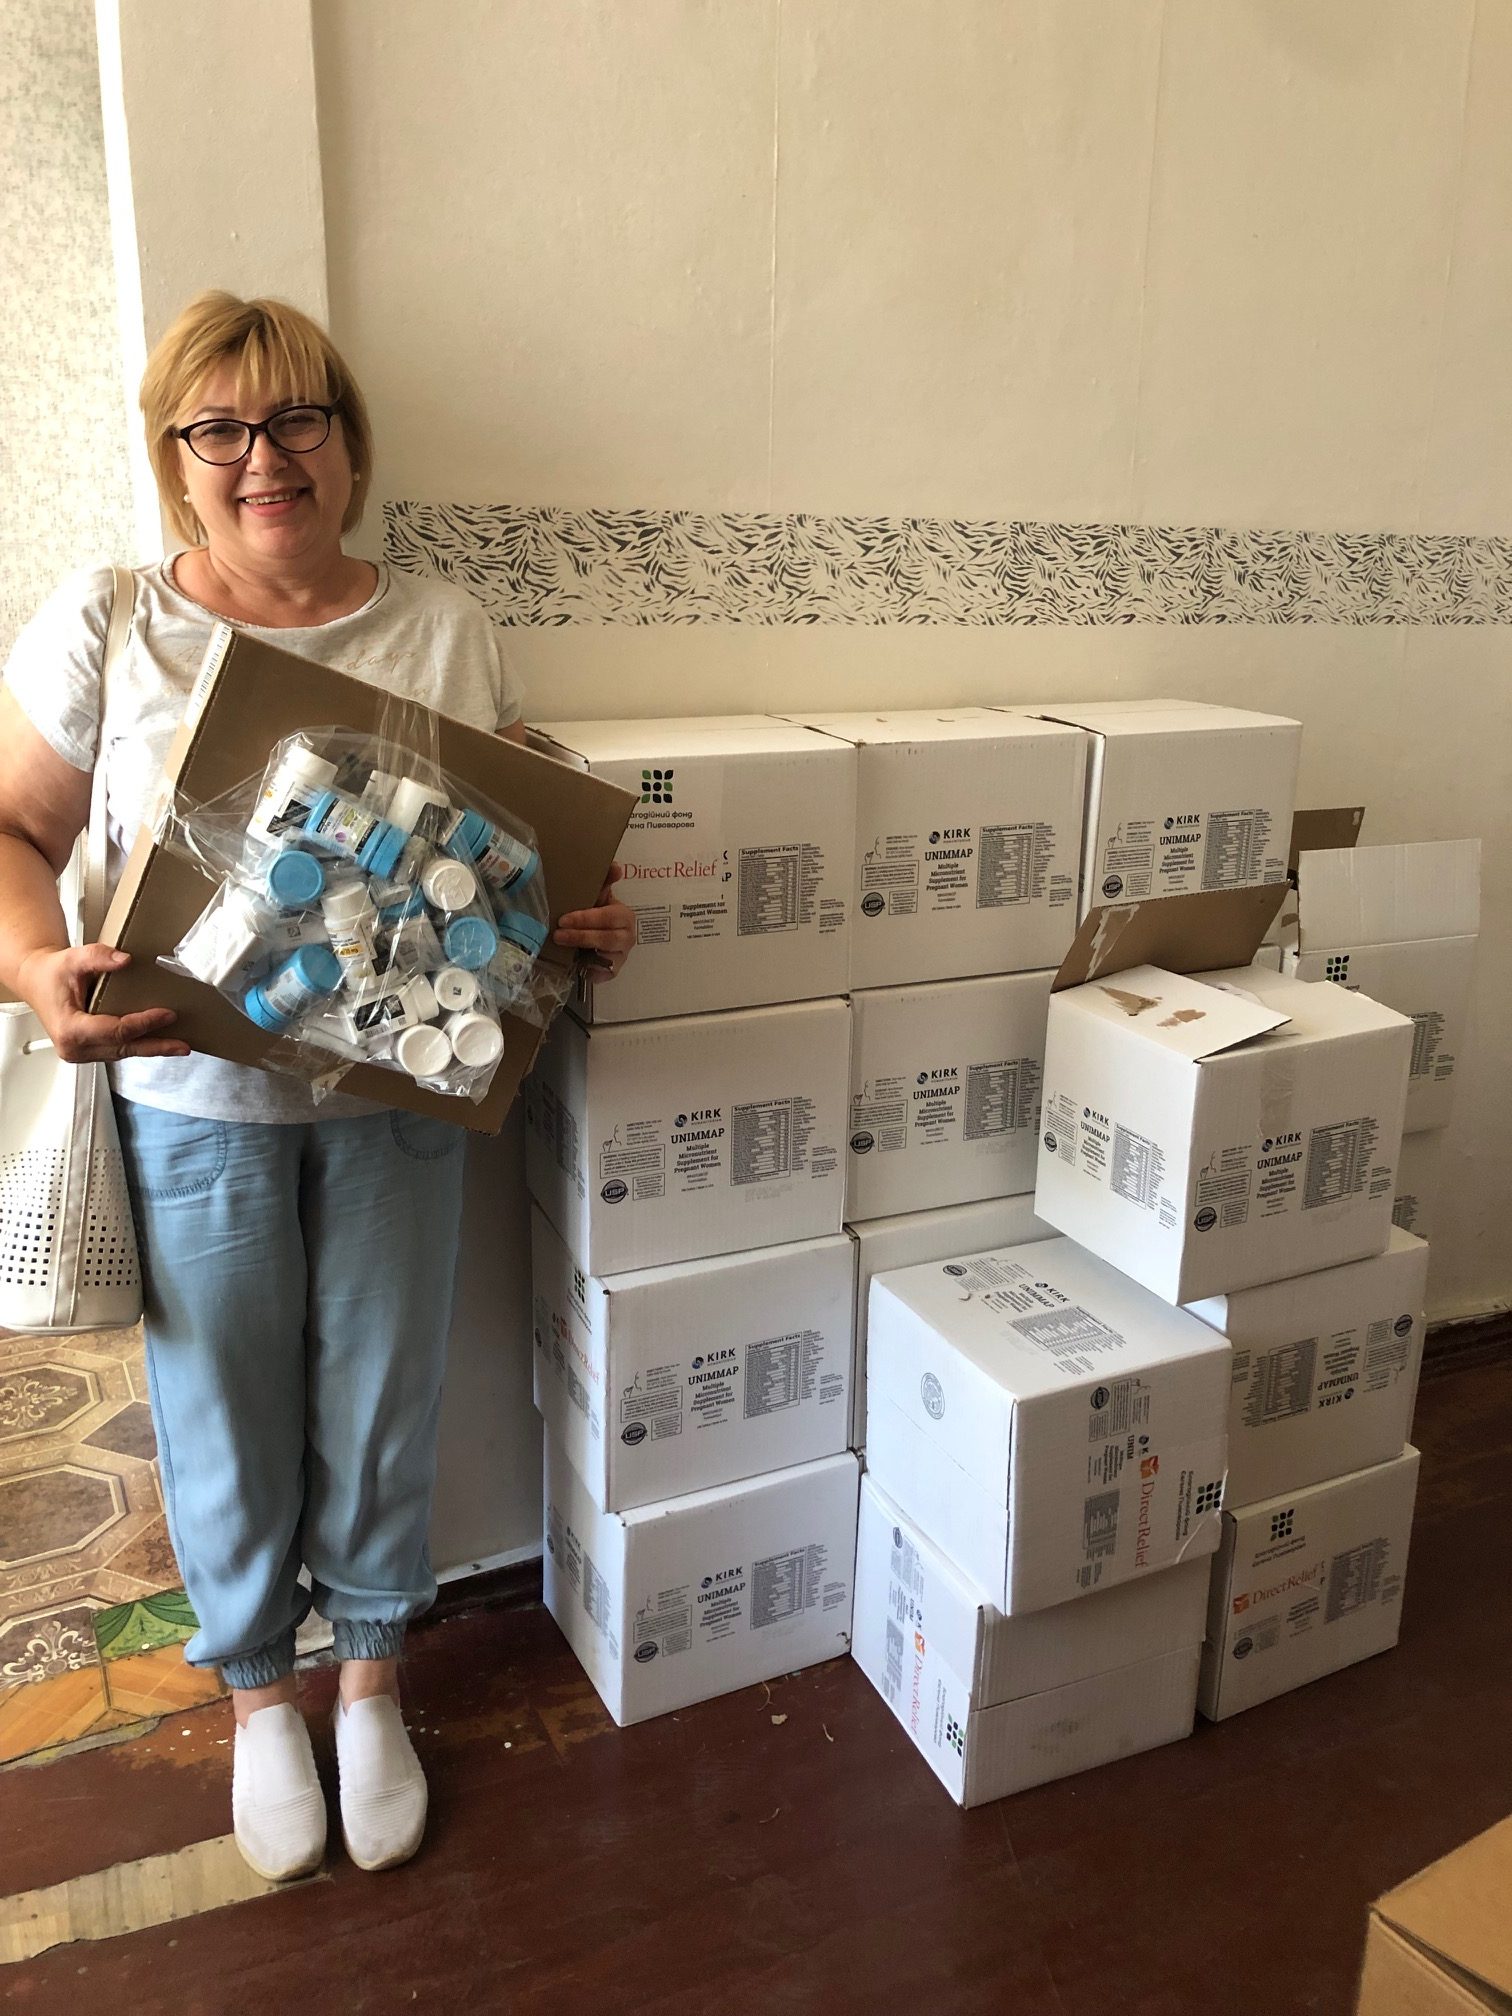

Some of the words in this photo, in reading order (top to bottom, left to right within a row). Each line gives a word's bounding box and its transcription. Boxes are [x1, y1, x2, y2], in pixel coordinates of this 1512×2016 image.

[631, 810, 670, 821] агодійний
[672, 811, 693, 819] фонд
[1176, 814, 1200, 825] KIRK
[647, 821, 694, 829] Пивоварова
[943, 828, 971, 839] KIRK
[1160, 834, 1201, 845] UNIMMAP
[741, 847, 781, 855] Supplement
[925, 849, 973, 861] UNIMMAP
[682, 902, 716, 911] Supplement
[680, 910, 705, 918] Pregnant
[931, 1068, 958, 1079] KIRK
[913, 1086, 960, 1100] UNIMMAP
[691, 1108, 721, 1121] KIRK
[1092, 1110, 1110, 1126] KIRK
[671, 1128, 724, 1144] UNIMMAP
[1080, 1121, 1110, 1143] UNIMMAP
[1276, 1132, 1301, 1146] KIRK
[686, 1143, 709, 1151] Multiple
[679, 1149, 717, 1159] Micronutrient
[1257, 1152, 1303, 1169] UNIMMAP
[677, 1156, 710, 1166] Supplement
[674, 1165, 699, 1173] Pregnant
[1019, 1284, 1055, 1308] UNIMMAP
[1047, 1288, 1072, 1303] KIRK
[707, 1348, 736, 1363] KIRK
[688, 1366, 739, 1385] UNIMMAP
[1317, 1372, 1359, 1391] UNIMMAP
[1318, 1394, 1343, 1409] KIRK
[715, 1566, 743, 1581] KIRK
[698, 1583, 746, 1604] UNIMMAP
